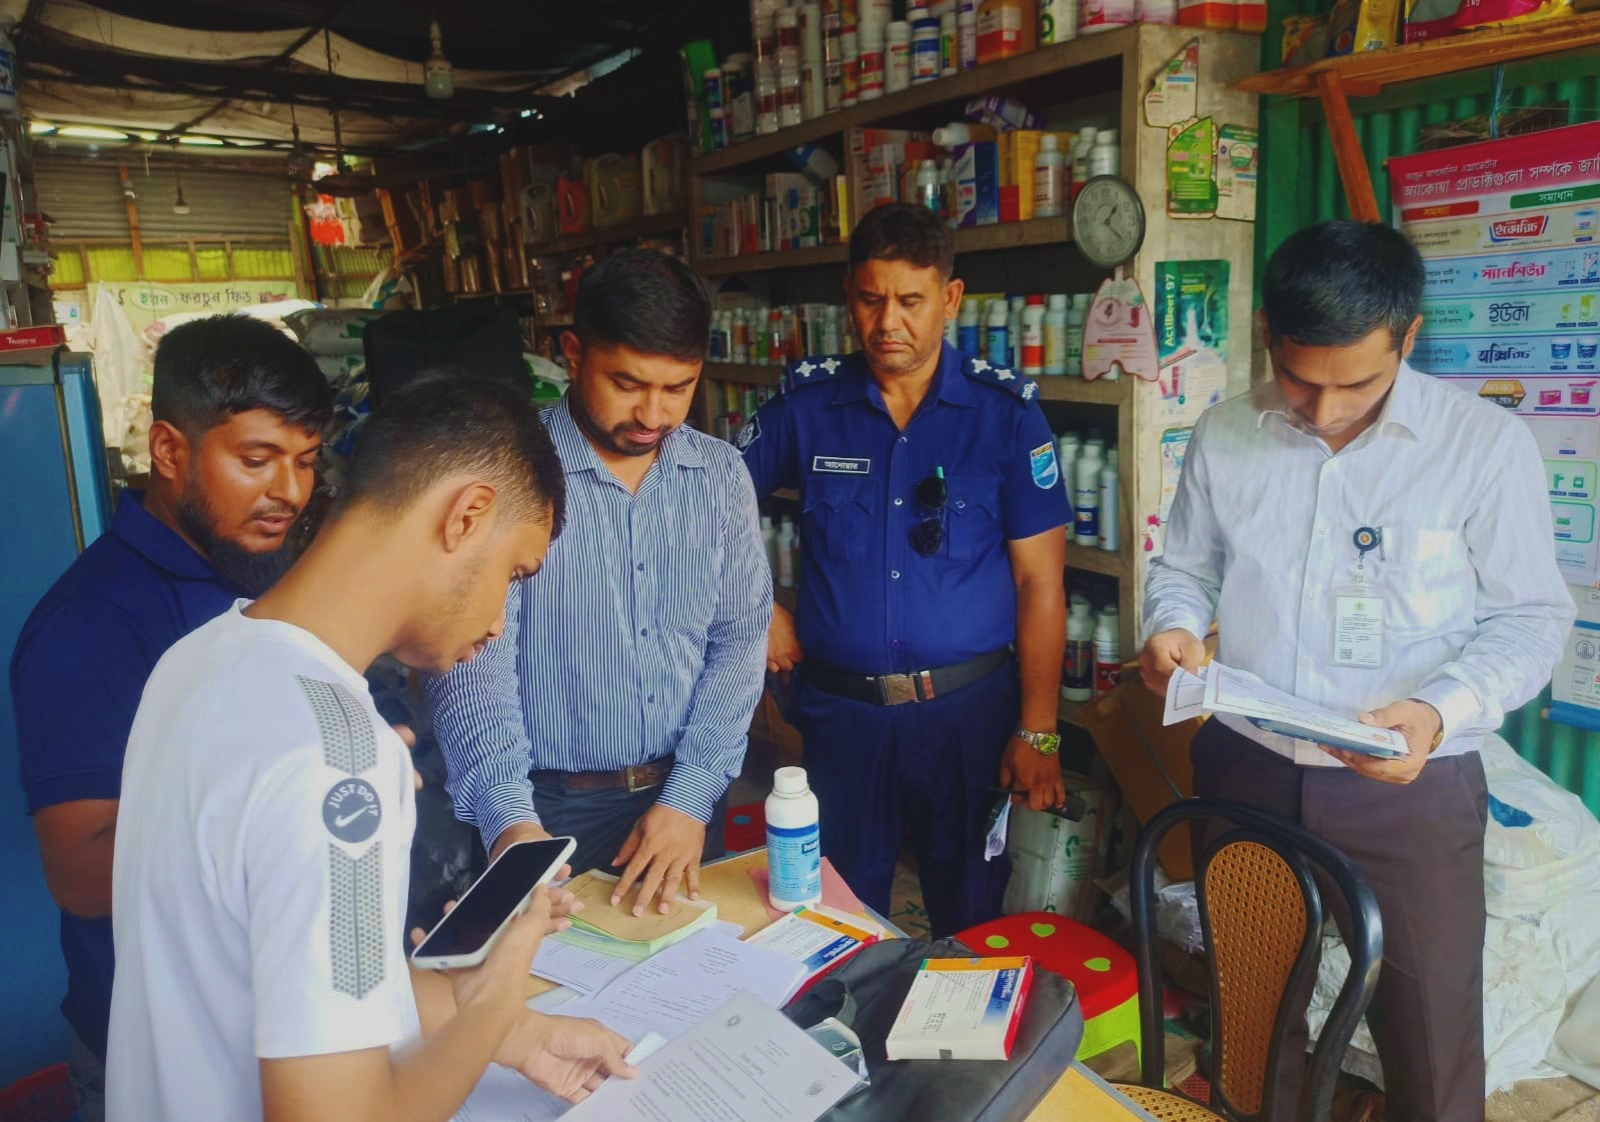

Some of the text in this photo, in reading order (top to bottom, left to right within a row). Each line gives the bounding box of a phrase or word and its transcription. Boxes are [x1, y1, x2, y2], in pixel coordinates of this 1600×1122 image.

[1539, 190, 1574, 202] সমাধান
[1165, 273, 1175, 290] 97
[1488, 302, 1531, 322] ইউকা
[328, 783, 356, 808] JUST
[357, 785, 375, 802] DO
